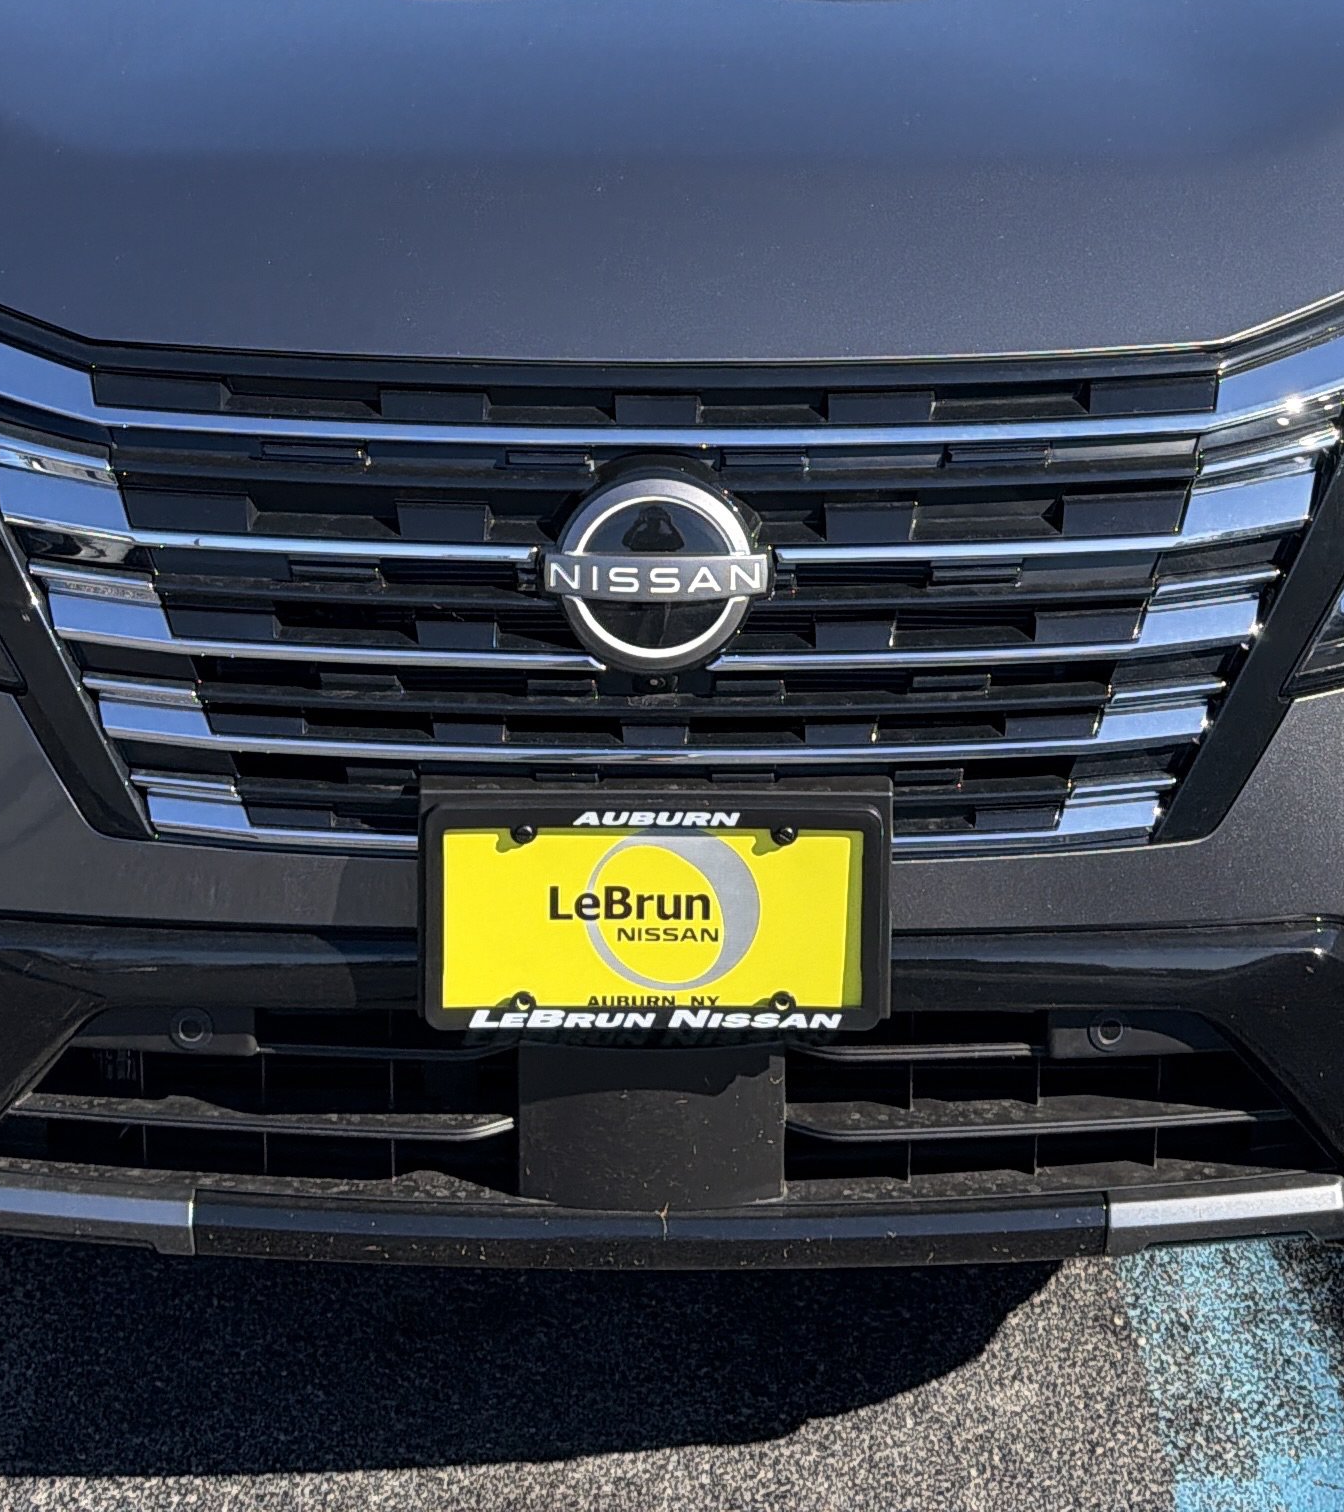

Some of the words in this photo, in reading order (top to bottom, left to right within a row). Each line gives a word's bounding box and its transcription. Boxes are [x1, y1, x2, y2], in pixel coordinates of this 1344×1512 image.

[549, 562, 761, 593] NISSAN
[573, 811, 741, 827] AUBURN
[549, 885, 711, 921] LeBrun
[617, 927, 720, 943] NISSAN
[690, 995, 721, 1007] NY
